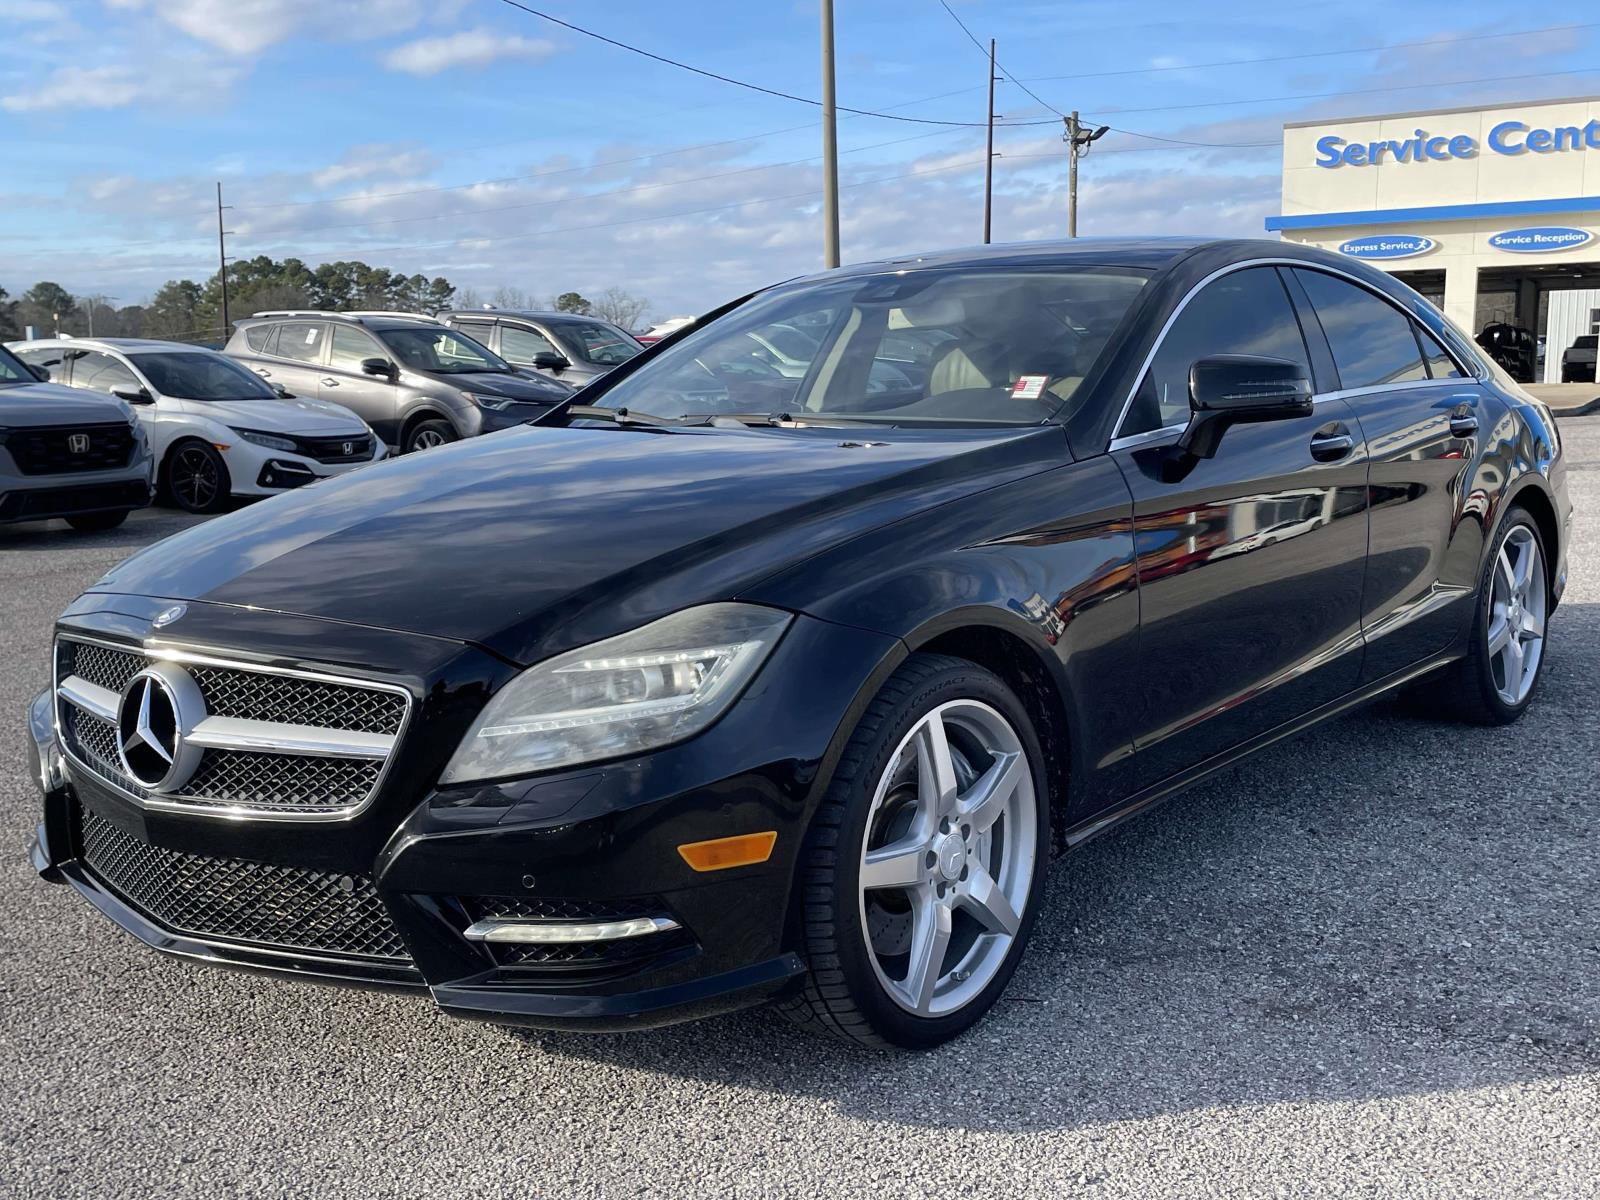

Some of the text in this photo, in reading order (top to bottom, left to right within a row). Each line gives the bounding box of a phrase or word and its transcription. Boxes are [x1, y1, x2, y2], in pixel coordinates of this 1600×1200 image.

[1315, 119, 1600, 168] Service Cent
[1494, 232, 1585, 245] Service Reception
[1343, 241, 1414, 253] Express Service
